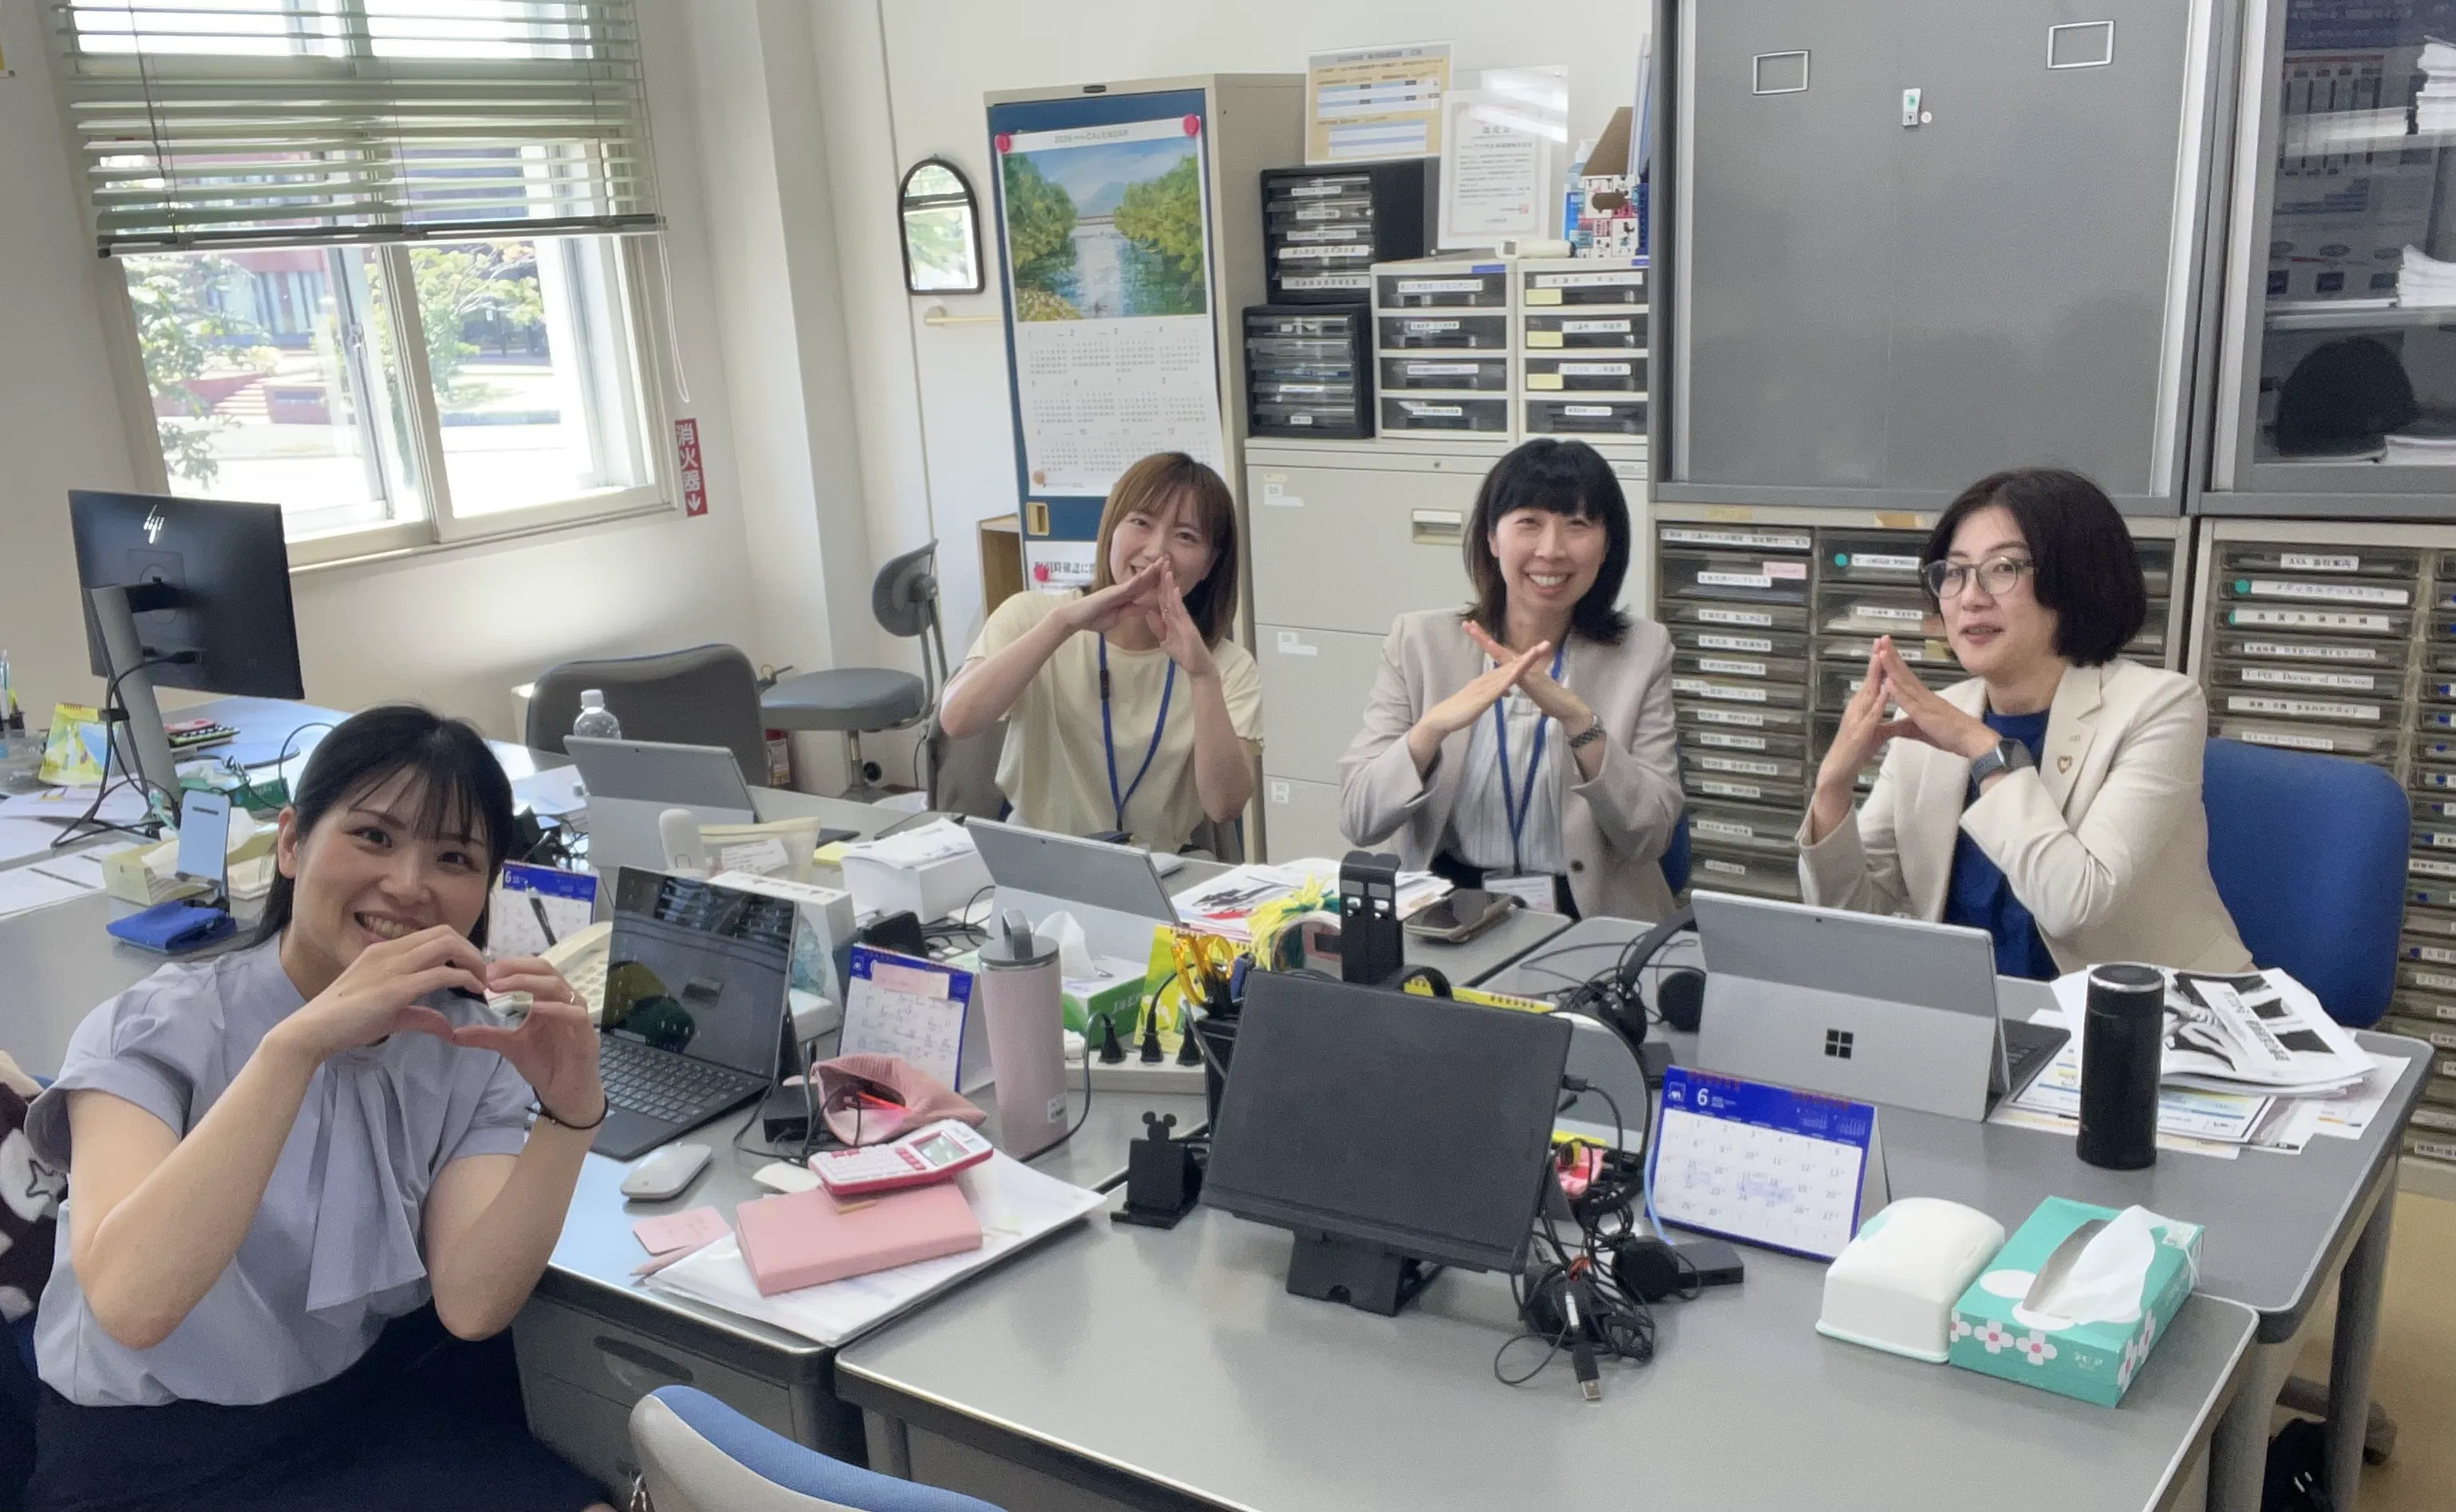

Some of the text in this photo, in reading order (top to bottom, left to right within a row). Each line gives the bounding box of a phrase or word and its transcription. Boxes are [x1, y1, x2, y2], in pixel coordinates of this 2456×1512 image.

[675, 422, 701, 492] 消火器
[505, 870, 512, 884] 6
[1697, 1088, 1709, 1107] 6
